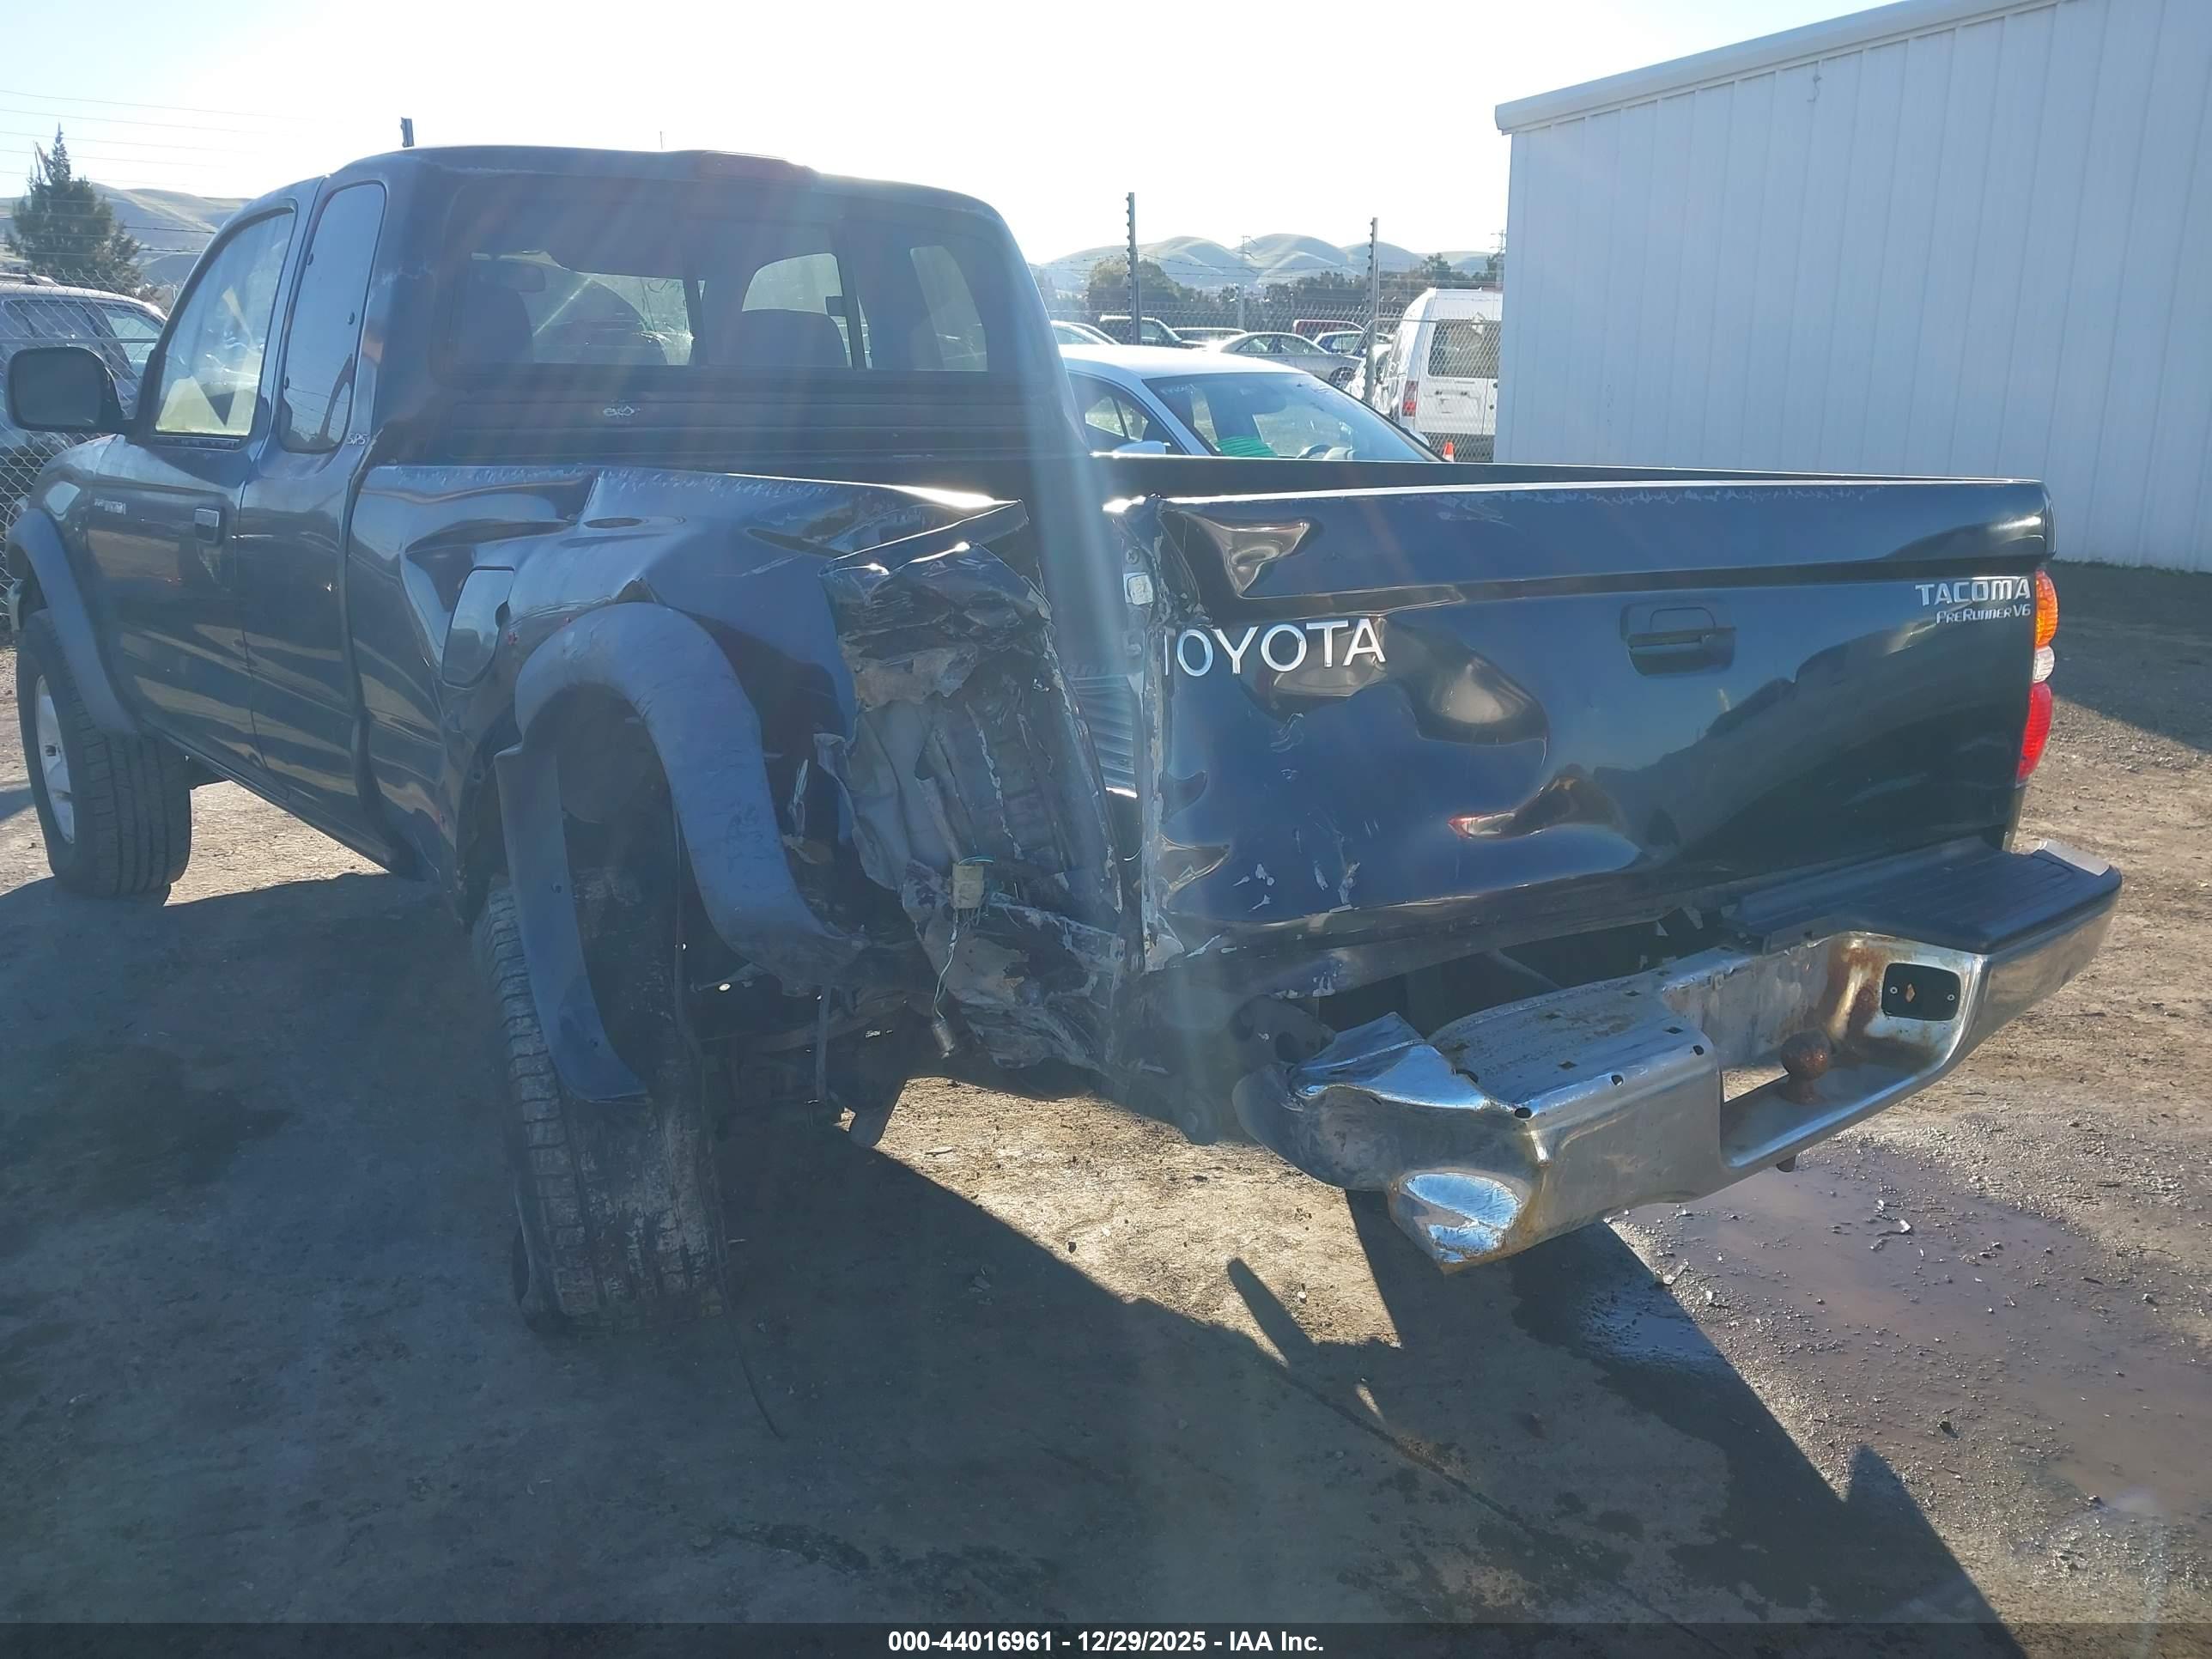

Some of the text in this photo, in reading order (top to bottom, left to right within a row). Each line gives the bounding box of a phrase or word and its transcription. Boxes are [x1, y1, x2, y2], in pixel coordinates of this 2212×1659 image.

[1915, 578, 2032, 606] TACOMA
[2013, 603, 2032, 617] V6
[1164, 617, 1387, 677] OYOTA
